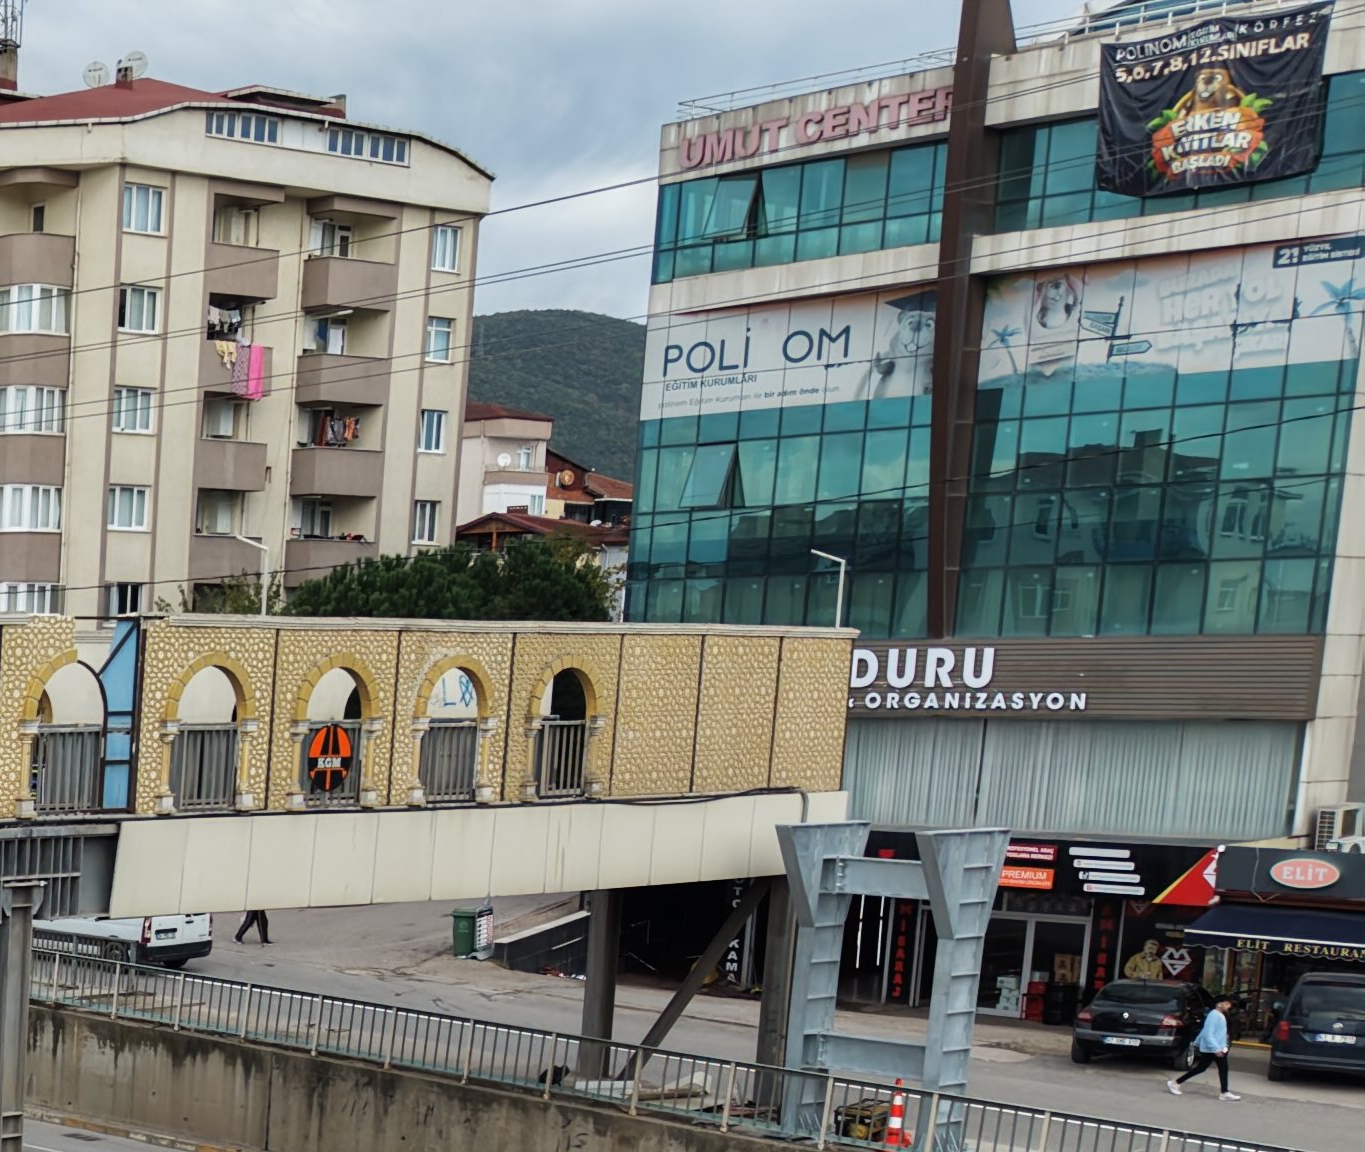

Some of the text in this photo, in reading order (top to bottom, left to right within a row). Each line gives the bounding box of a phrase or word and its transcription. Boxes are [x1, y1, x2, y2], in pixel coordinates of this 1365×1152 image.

[679, 118, 788, 168] UMUT
[701, 373, 758, 388] KURUMLARI
[850, 647, 995, 689] DURU
[864, 692, 1087, 710] ORGANİZASYON
[317, 758, 342, 769] KGM
[1281, 864, 1329, 881] ELİT
[1236, 939, 1270, 950] ELİT
